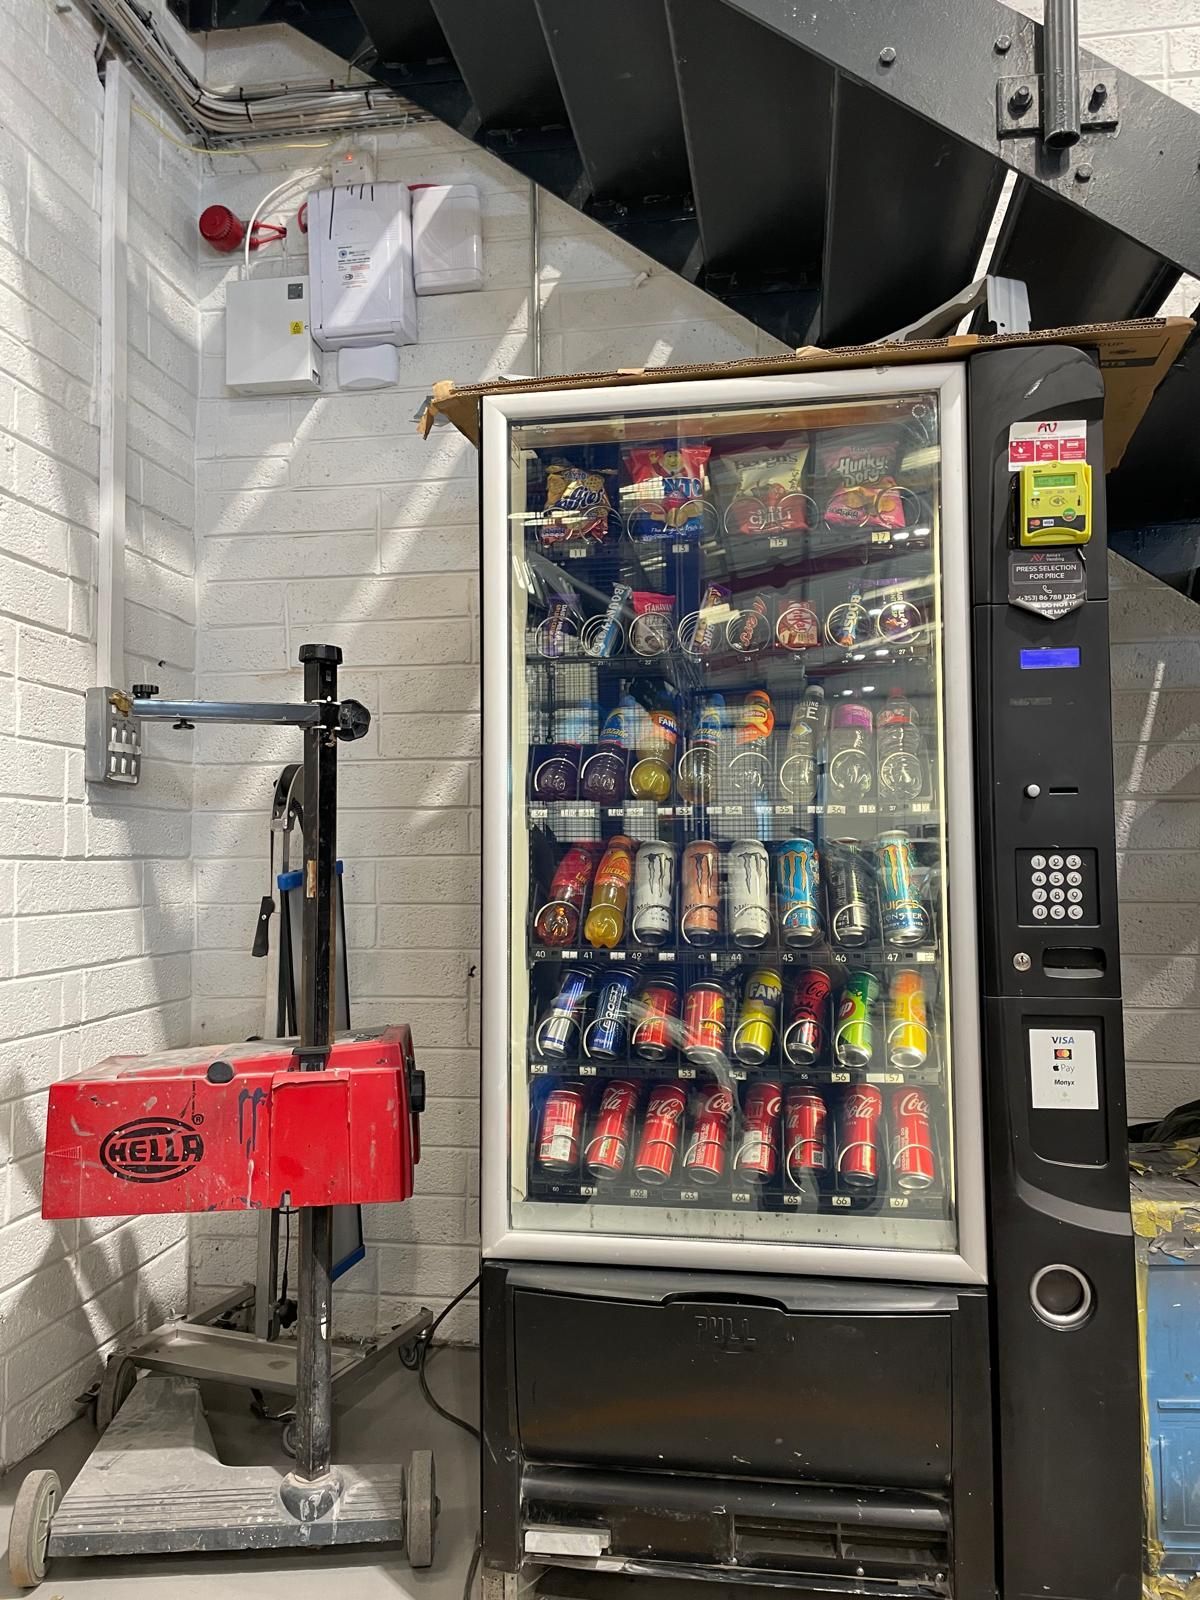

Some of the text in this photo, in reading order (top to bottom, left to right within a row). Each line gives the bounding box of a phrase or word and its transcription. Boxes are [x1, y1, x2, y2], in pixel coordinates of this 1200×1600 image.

[1038, 564, 1077, 572] SELECTION
[1053, 858, 1060, 867] 2
[1071, 858, 1077, 867] 3
[1036, 874, 1077, 883] 4 5 6
[1037, 891, 1078, 900] 7 8 9
[1037, 908, 1044, 917] 0
[1071, 908, 1079, 917] C
[535, 950, 546, 958] 40
[583, 951, 593, 959] 41
[782, 953, 794, 962] 45
[835, 954, 847, 962] 46
[887, 953, 899, 962] 47
[1051, 1036, 1075, 1044] VISA
[534, 1065, 545, 1073] 50
[583, 1066, 594, 1074] 51
[1060, 1063, 1075, 1074] Pay
[834, 1073, 847, 1082] 56
[888, 1074, 899, 1082] 57
[1054, 1079, 1075, 1087] Monyx
[108, 1133, 204, 1163] HELLA
[787, 1196, 799, 1204] 65
[836, 1197, 848, 1205] 66
[894, 1199, 905, 1207] 67
[694, 1315, 756, 1341] PULL
